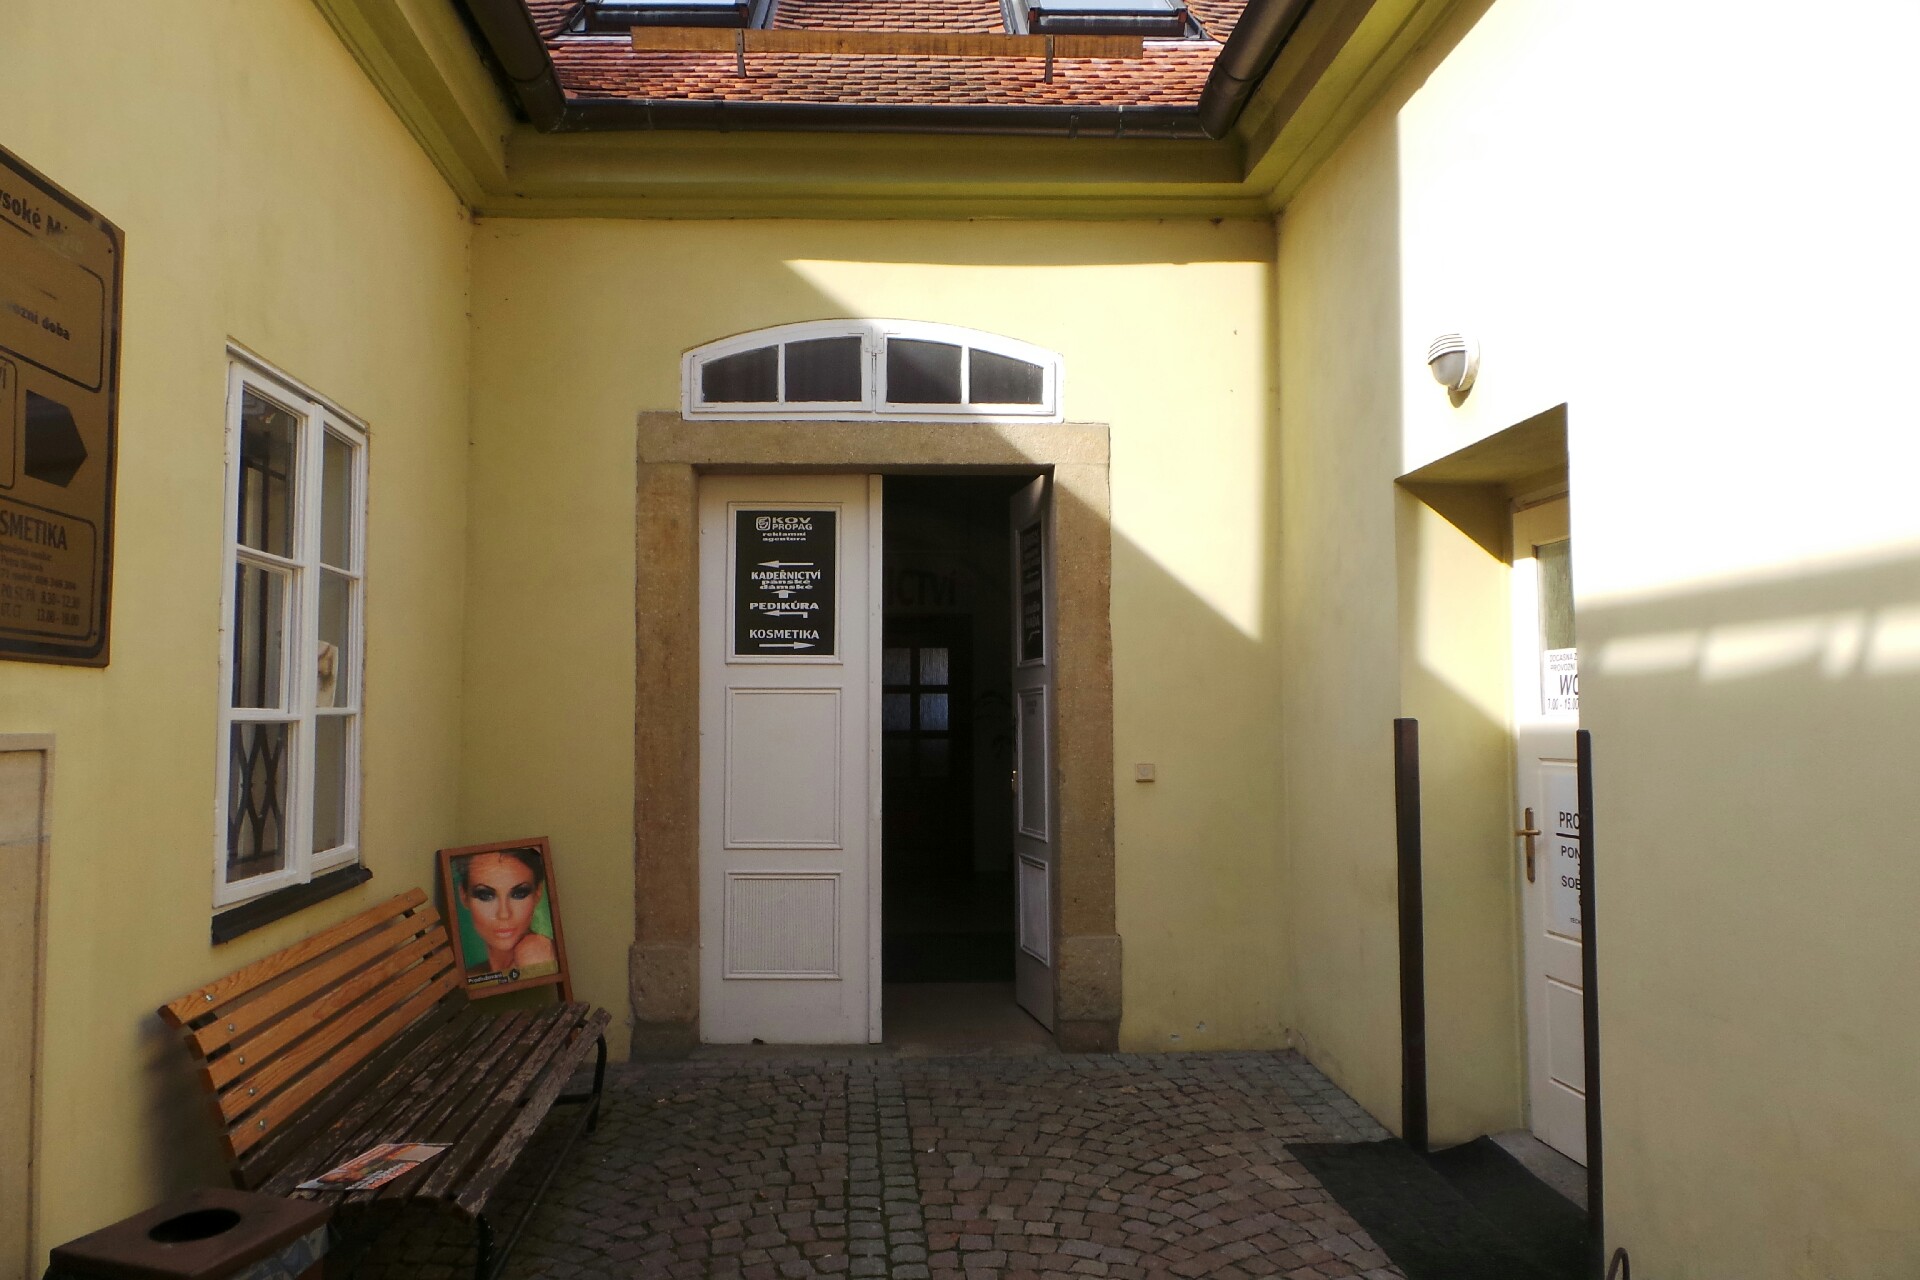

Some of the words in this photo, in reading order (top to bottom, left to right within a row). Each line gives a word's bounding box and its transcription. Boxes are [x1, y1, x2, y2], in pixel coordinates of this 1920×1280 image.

[42, 317, 70, 341] doba
[772, 516, 811, 524] KOV
[772, 523, 813, 531] PROPAG
[751, 569, 821, 580] KADEŘNICTVÍ
[749, 600, 819, 610] PEDIKÚRA
[749, 629, 820, 639] KOSMETIKA
